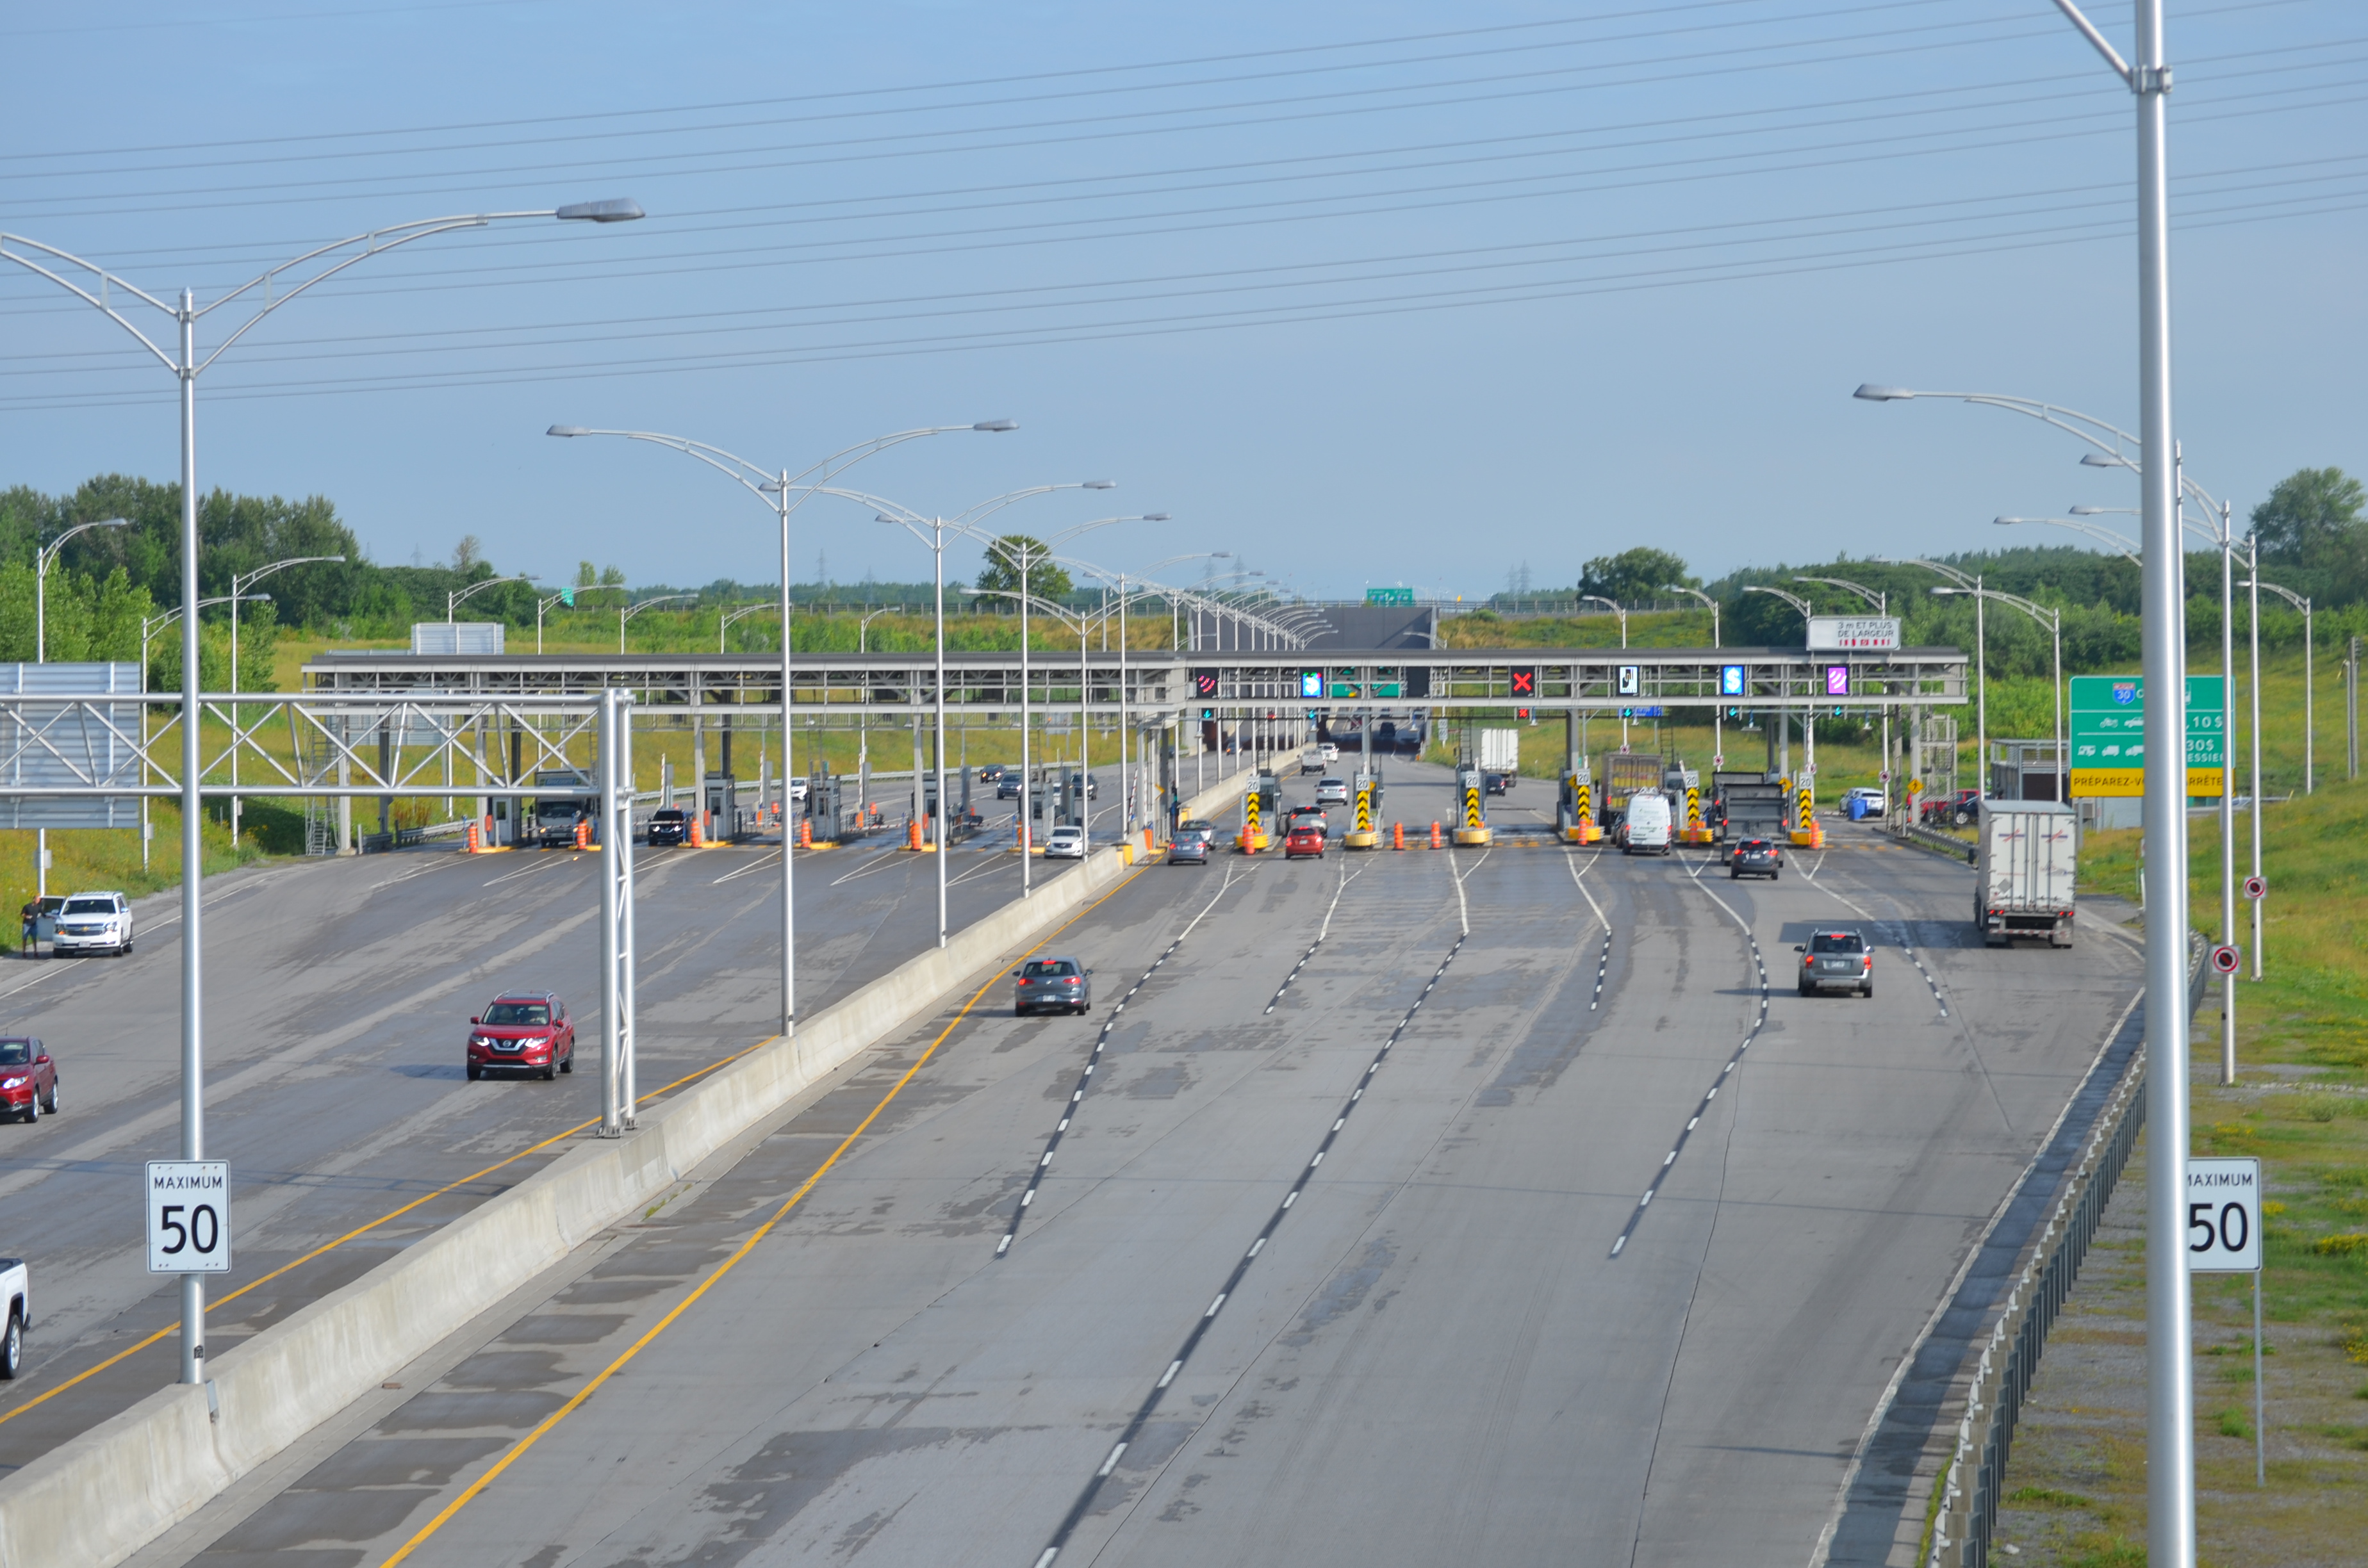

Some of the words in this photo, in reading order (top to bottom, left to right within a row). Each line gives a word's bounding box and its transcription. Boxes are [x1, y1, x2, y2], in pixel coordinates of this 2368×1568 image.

[2117, 690, 2131, 699] 30
[1467, 776, 1477, 785] 20
[1579, 774, 1589, 783] 20
[1686, 776, 1697, 785] 20
[1801, 778, 1811, 787] 20
[2074, 774, 2144, 787] PRÉPAREZ-V
[1248, 781, 1258, 790] 20
[1358, 780, 1368, 788] 20
[154, 1176, 222, 1189] MAXIMUM
[161, 1204, 218, 1254] 50
[2189, 1202, 2248, 1252] 50
